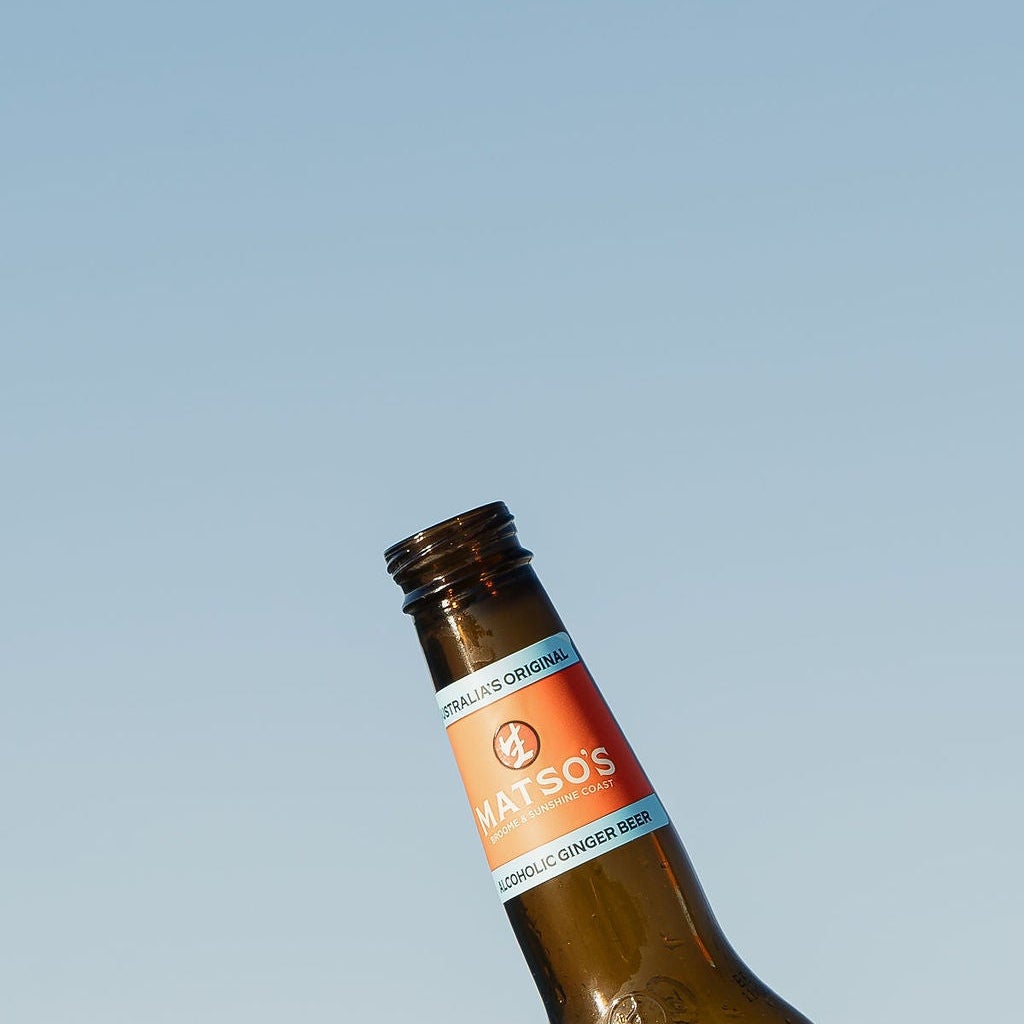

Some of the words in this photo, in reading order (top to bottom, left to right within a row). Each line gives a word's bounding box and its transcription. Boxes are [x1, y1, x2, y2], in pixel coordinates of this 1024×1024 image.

[503, 647, 569, 686] ORIGINAL
[475, 747, 616, 836] MATSO'S
[489, 819, 520, 845] BROOME
[520, 814, 528, 823] &
[528, 790, 580, 819] SUNSHINE
[581, 778, 615, 797] COAST
[558, 826, 617, 863] GINGER
[617, 810, 653, 834] BEER
